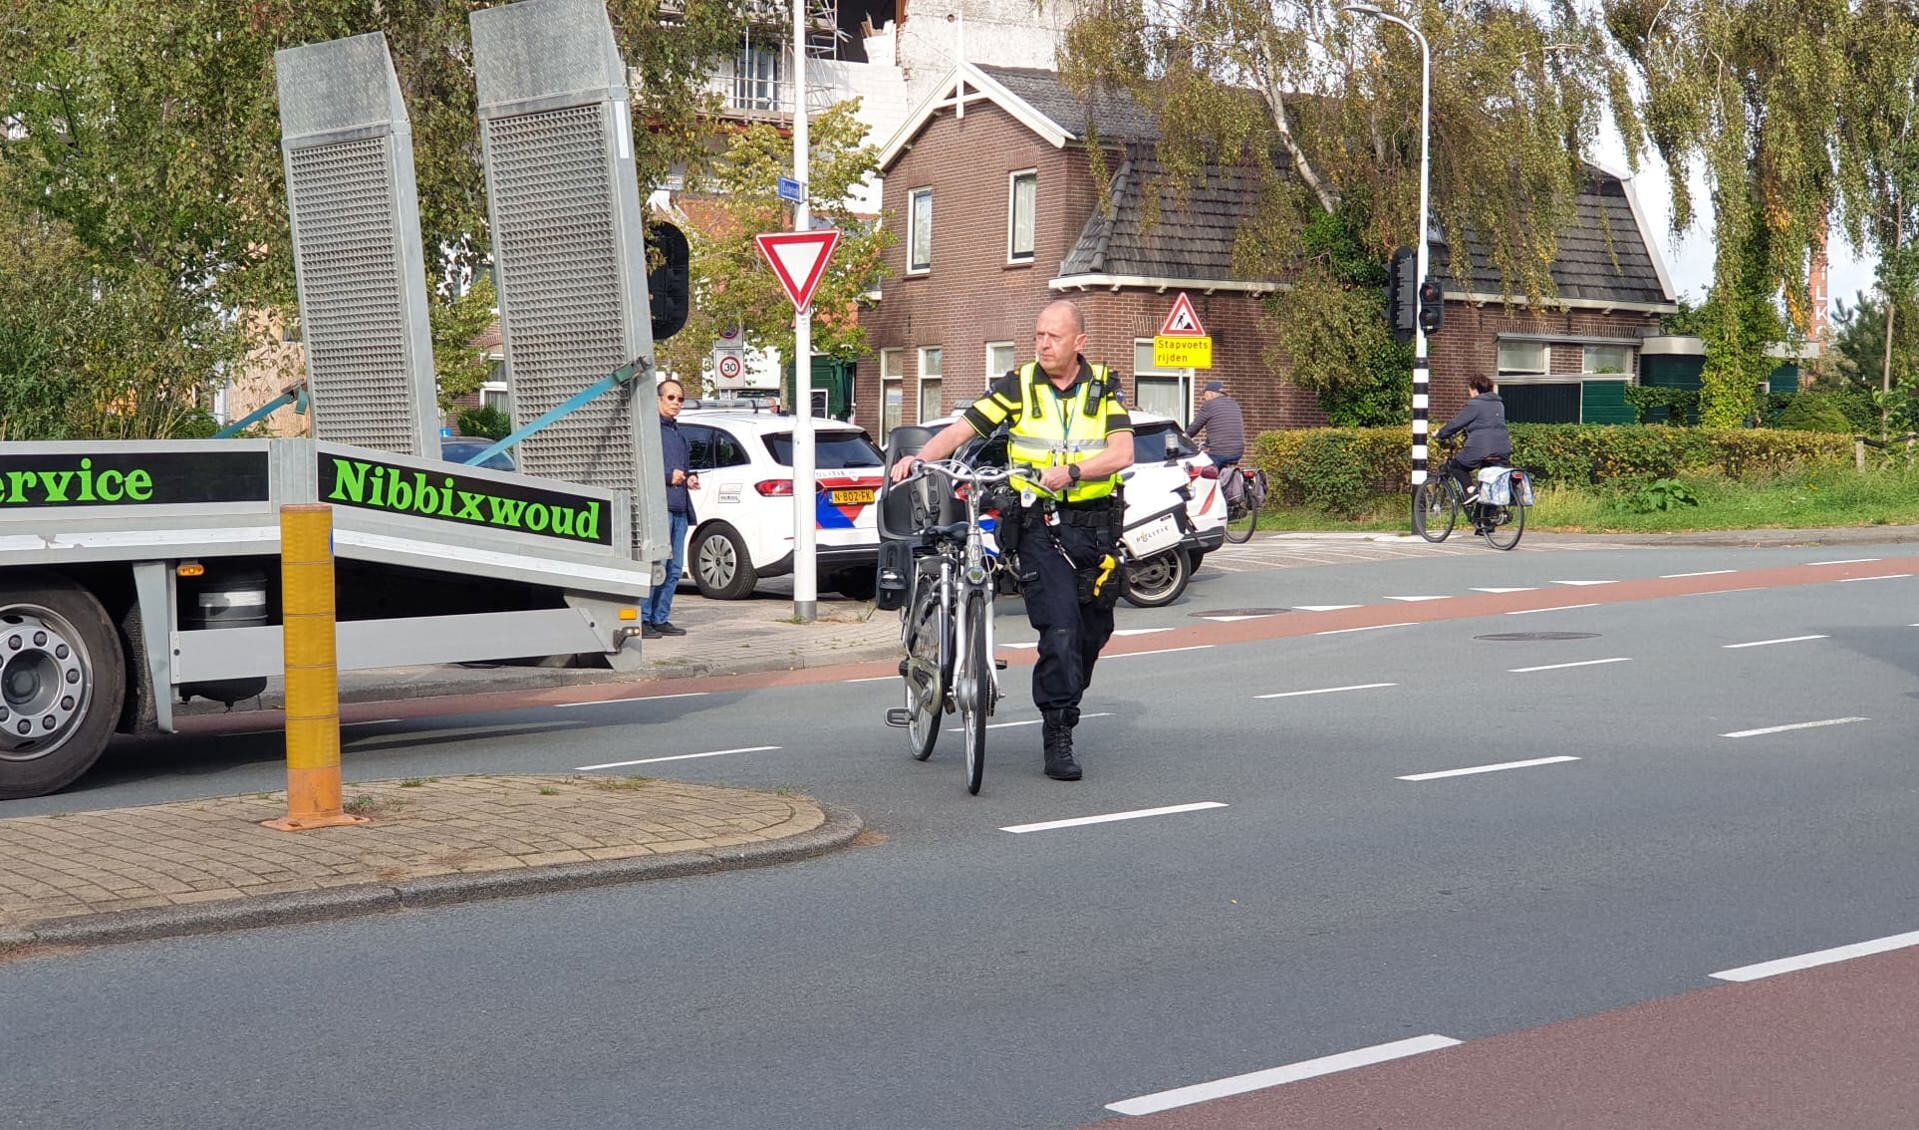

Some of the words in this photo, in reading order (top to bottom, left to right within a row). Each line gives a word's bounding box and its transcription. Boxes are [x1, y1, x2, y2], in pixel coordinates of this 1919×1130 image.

[1158, 339, 1208, 350] Stapvoets
[1158, 353, 1188, 364] rijden
[724, 363, 737, 372] 30
[443, 429, 449, 438] L
[0, 457, 153, 504] rvice
[327, 457, 601, 540] Nibbixwoud
